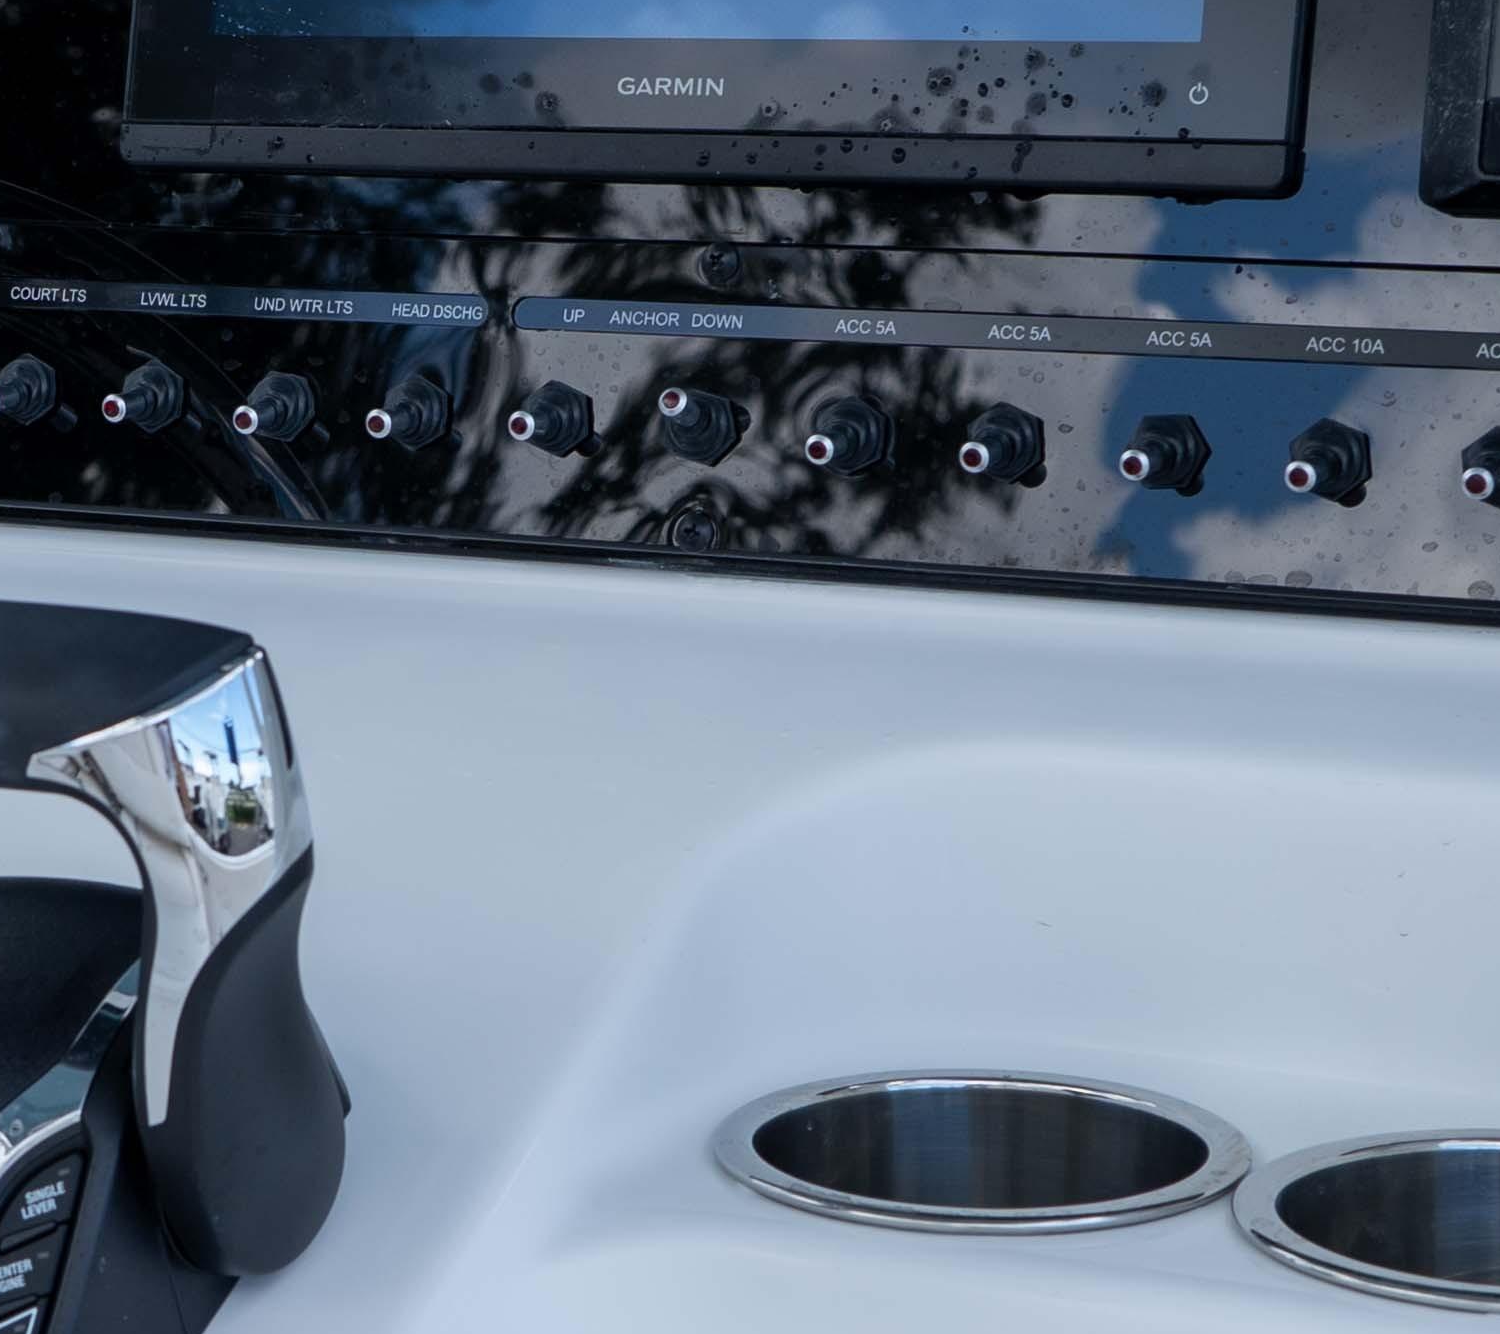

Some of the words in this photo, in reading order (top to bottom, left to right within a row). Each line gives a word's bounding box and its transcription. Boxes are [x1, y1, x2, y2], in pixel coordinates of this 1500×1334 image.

[616, 76, 726, 97] GARMIN
[10, 286, 58, 303] COURT
[61, 288, 87, 304] LTS
[140, 291, 178, 307] LVWL
[180, 293, 207, 309] LTS
[254, 297, 285, 312] UND
[289, 298, 322, 314] WTR
[325, 299, 353, 315] LTS
[391, 303, 429, 318] HEAD
[432, 304, 483, 321] DSCHG
[563, 308, 585, 324] UP
[609, 310, 680, 328] ANCHOR
[691, 313, 743, 330] DOWN
[835, 319, 873, 335] ACC
[876, 320, 896, 336] 5A
[988, 324, 1026, 341] ACC
[1030, 326, 1052, 343] 5A
[1146, 330, 1186, 348] ACC
[1189, 331, 1212, 349] 5A
[1305, 336, 1345, 354] ACC
[1350, 337, 1385, 355] 10A
